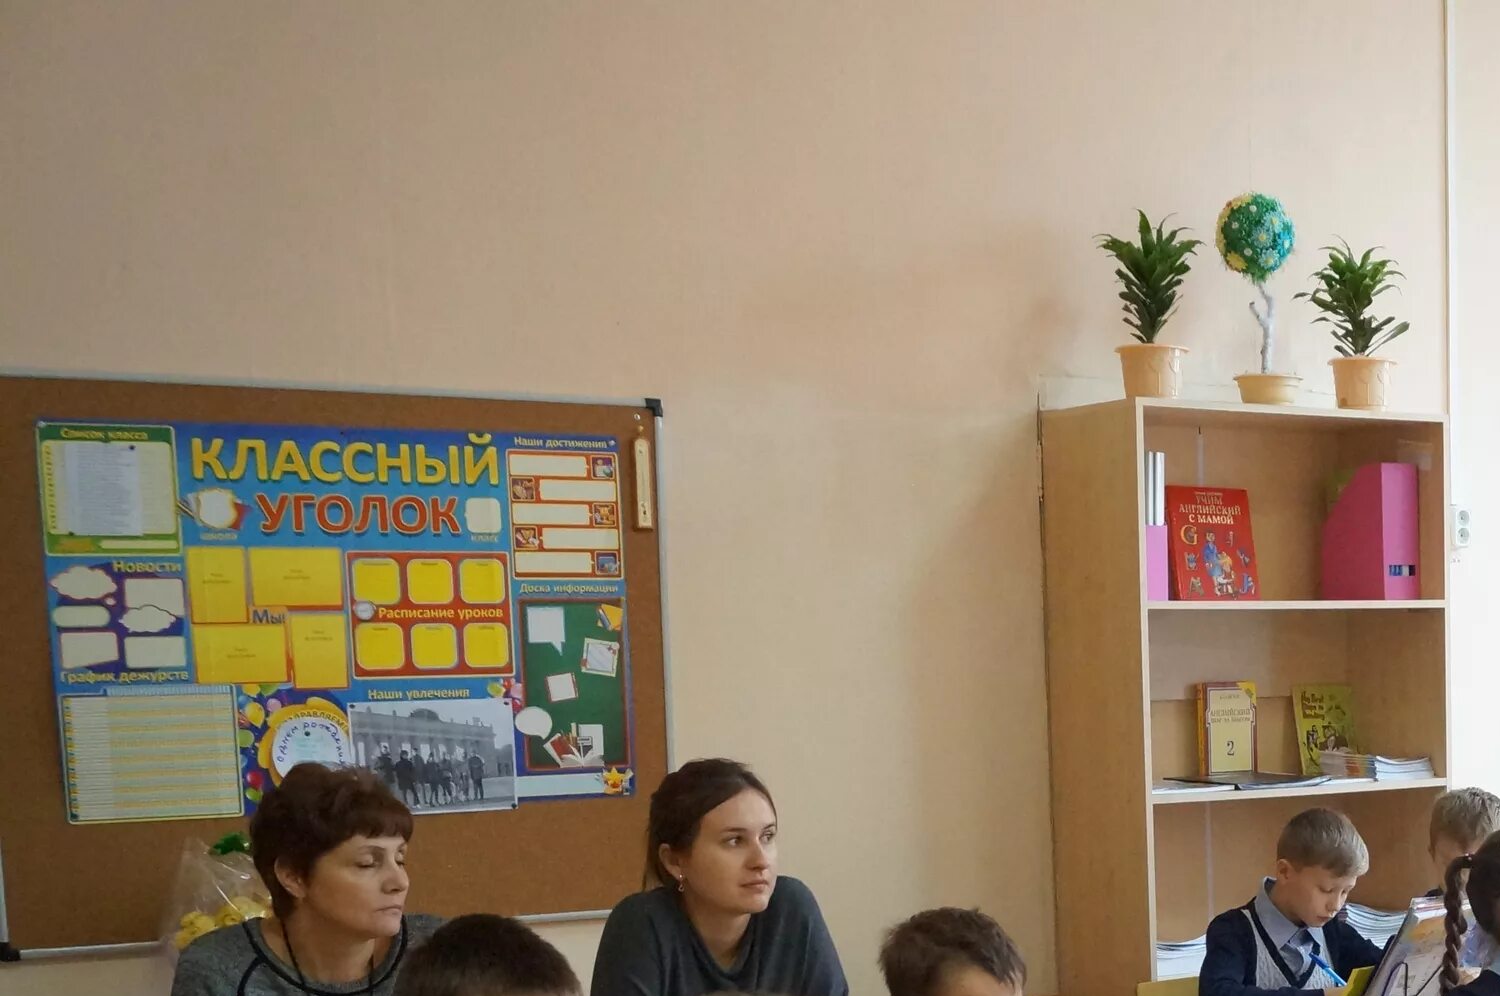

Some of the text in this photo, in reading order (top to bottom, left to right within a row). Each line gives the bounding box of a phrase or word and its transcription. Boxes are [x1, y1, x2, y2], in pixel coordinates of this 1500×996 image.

[514, 436, 608, 449] Наши достижения
[190, 432, 499, 485] КЛАССНЫЙ
[1195, 495, 1223, 505] УЧИМ
[255, 492, 462, 535] УГОЛОК
[1179, 503, 1241, 516] АНГЛИЙСКИЙ
[1188, 513, 1234, 525] С МАМОЙ
[112, 560, 182, 573] Новости
[520, 583, 619, 594] Доска информации
[378, 607, 504, 620] Расписание уроков
[60, 670, 190, 685] График дежурств
[368, 688, 470, 700] Наши увлечения
[1226, 740, 1235, 756] 2
